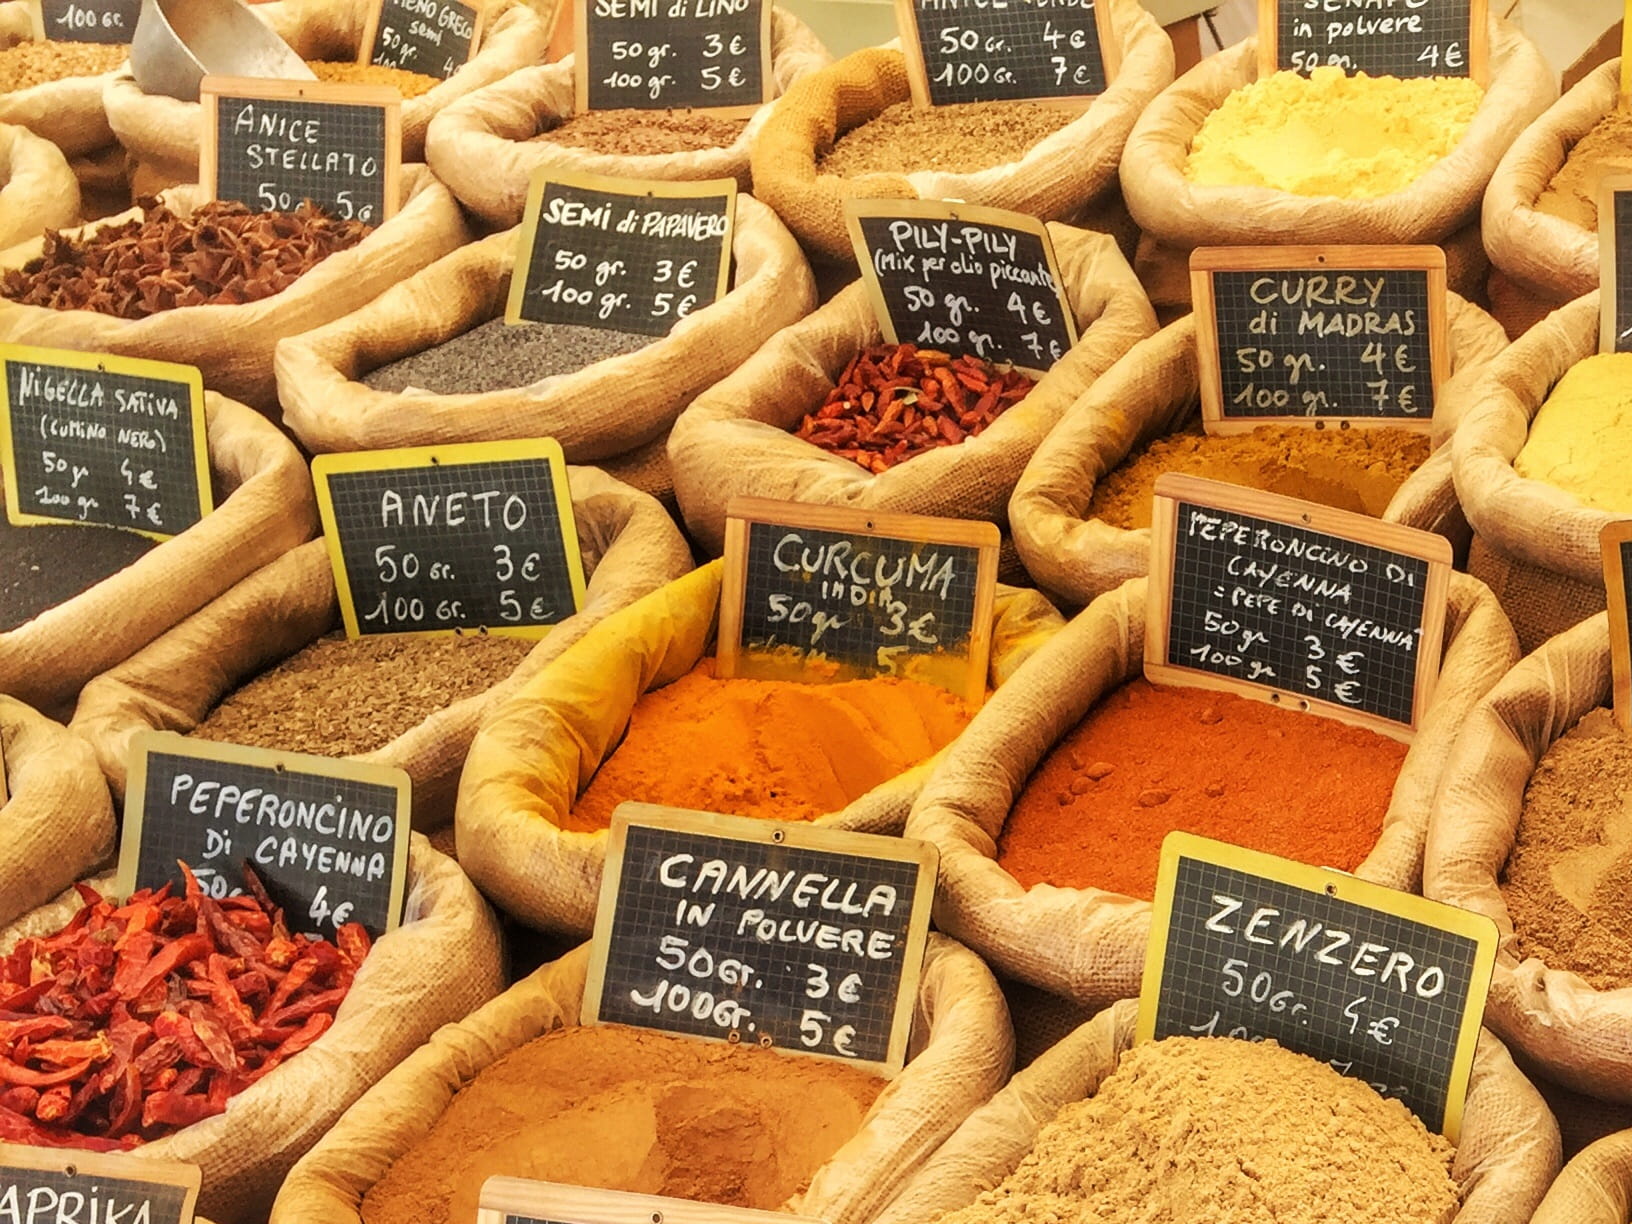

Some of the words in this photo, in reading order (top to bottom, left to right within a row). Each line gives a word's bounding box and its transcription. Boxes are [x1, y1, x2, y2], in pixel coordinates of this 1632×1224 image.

[56, 4, 97, 30] 100
[1293, 18, 1313, 38] in
[1326, 15, 1423, 45] polvere
[382, 27, 400, 49] 50
[612, 41, 643, 60] 50
[940, 27, 979, 54] 50
[933, 63, 989, 87] 100
[1291, 50, 1318, 72] 50
[603, 72, 643, 88] 100
[233, 103, 321, 144] ANICE
[246, 144, 378, 178] STELLATO
[616, 208, 640, 234] di
[641, 210, 730, 242] PAPAVERO
[889, 221, 1017, 262] PILY-PILY
[554, 249, 588, 271] 50
[921, 256, 946, 283] per
[951, 251, 983, 275] olio
[541, 279, 594, 306] 100
[903, 285, 936, 312] 50
[1250, 274, 1386, 309] CURRY
[917, 320, 960, 345] 100
[1249, 309, 1280, 337] di
[1297, 308, 1417, 339] MADRAS
[1236, 347, 1275, 374] 50
[1360, 341, 1388, 376] 4
[1232, 382, 1290, 408] 100
[1366, 378, 1390, 411] 7
[42, 451, 68, 474] 50
[35, 485, 71, 504] 100
[381, 489, 527, 531] ANETO
[1188, 510, 1369, 574] PEPERONCINO
[375, 544, 420, 584] 50
[493, 544, 514, 582] 3
[773, 533, 956, 601] CURCUMA
[1227, 555, 1354, 602] CAYENNA
[364, 591, 425, 626] 100
[499, 590, 523, 621] 5
[767, 593, 813, 623] 50
[1203, 609, 1240, 636] 50
[1189, 644, 1243, 667] 100
[170, 773, 394, 844] PEPERONCINO
[254, 836, 386, 882] CAYENNA
[659, 853, 898, 918] CANNELLA
[675, 899, 716, 927] IN
[736, 908, 896, 960] POLVERE
[1204, 894, 1445, 999] ZENZERO
